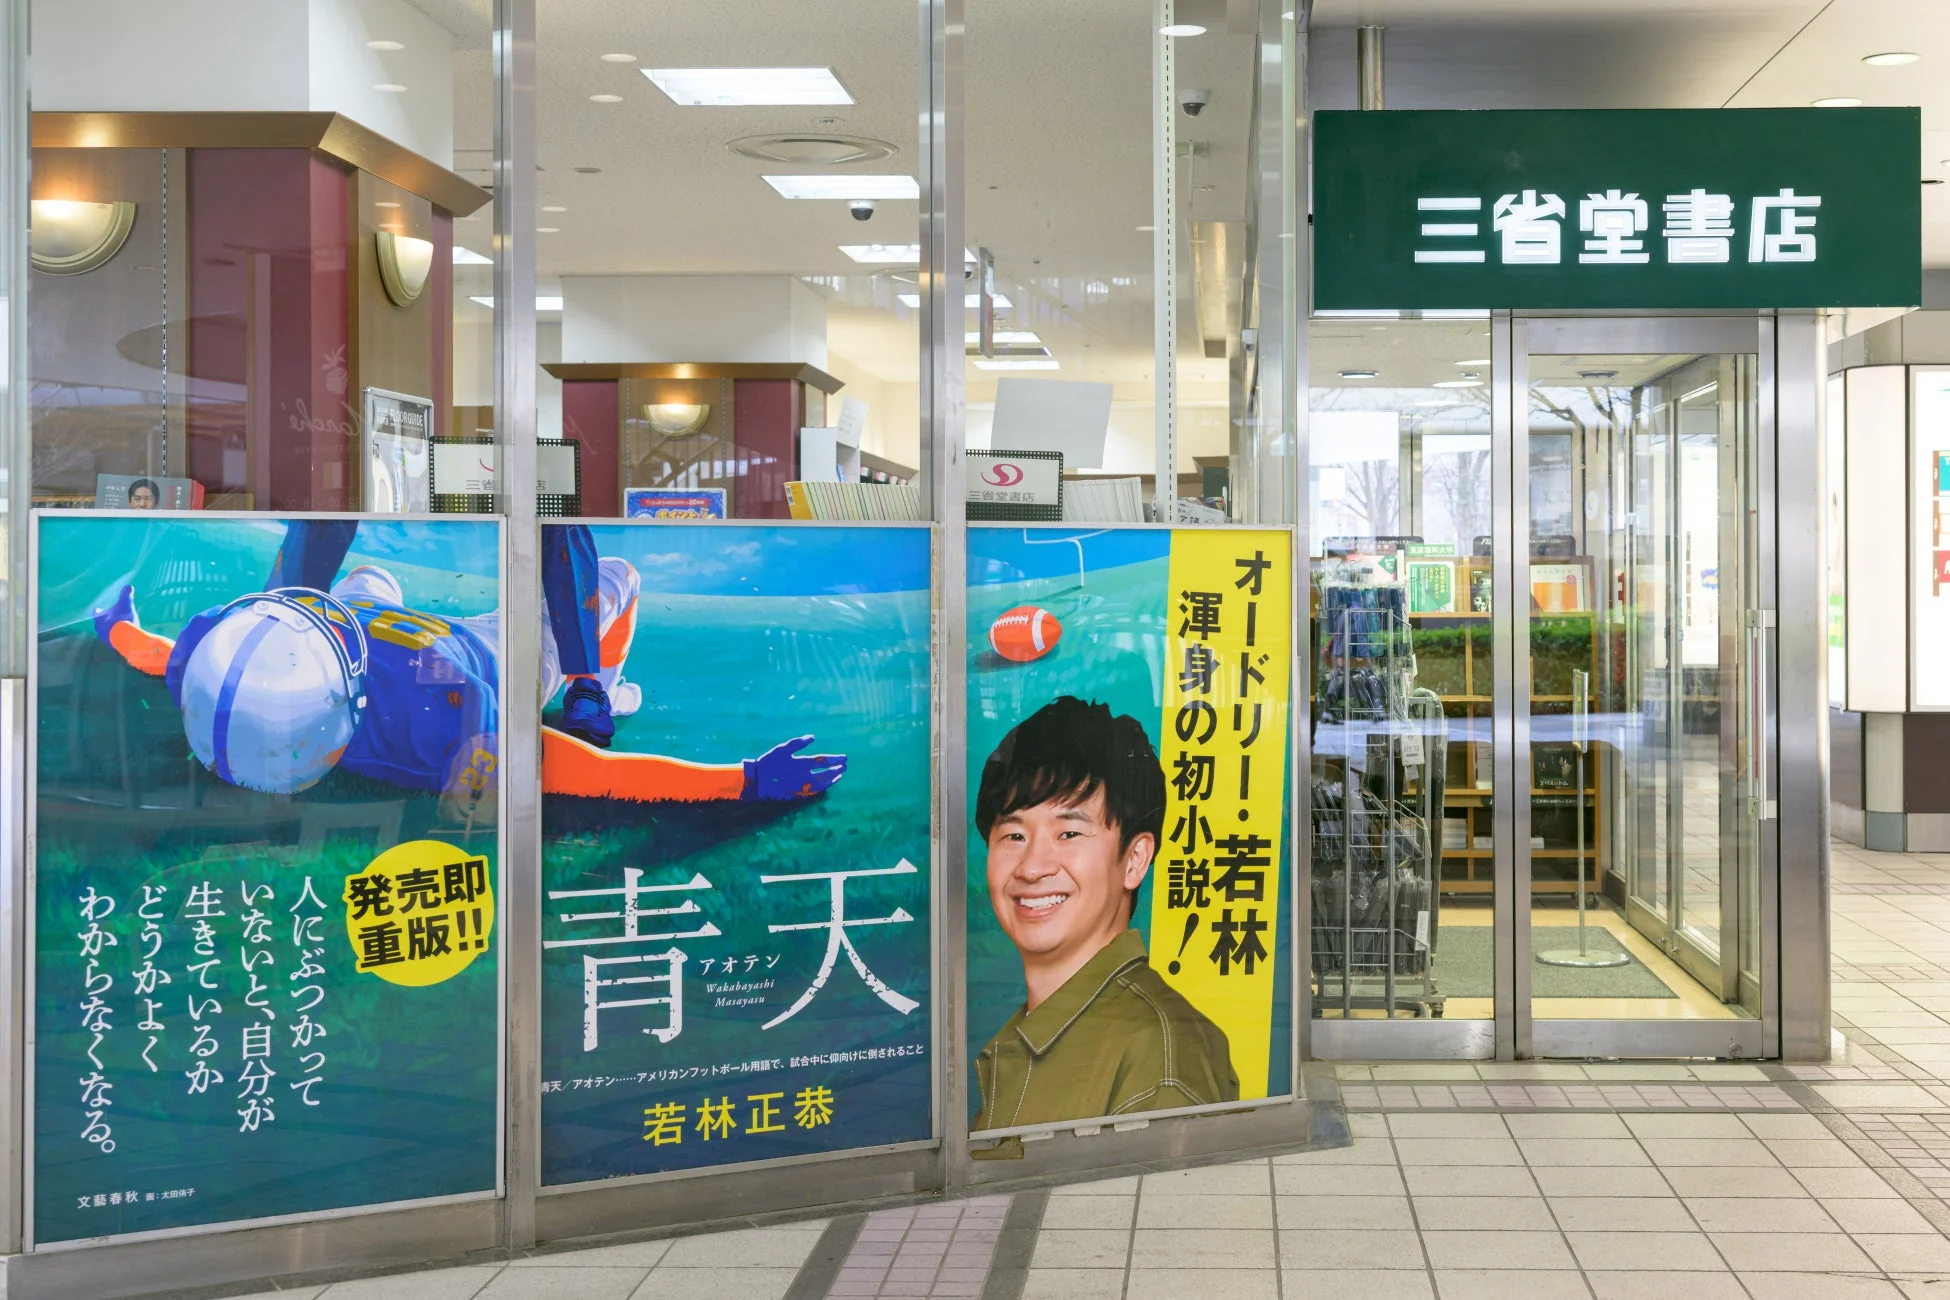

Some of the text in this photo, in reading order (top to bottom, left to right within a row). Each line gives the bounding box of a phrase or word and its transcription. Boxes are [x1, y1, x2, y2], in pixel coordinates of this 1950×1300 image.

[1414, 188, 1822, 264] 三省堂書店
[967, 490, 1035, 502] 三省堂書店
[1208, 550, 1272, 976] オードリー・若林
[348, 860, 486, 921] 発売即
[132, 885, 171, 1073] どうかよく
[184, 881, 226, 1095] 生きているか
[289, 876, 328, 1106] 人にぶつかって
[542, 857, 921, 1052] 青天
[699, 953, 781, 976] アオテン
[706, 979, 776, 994] Wakabayashi
[77, 886, 118, 1154] わからなくなる。
[237, 880, 277, 1133] いないと、自分が
[714, 996, 766, 1008] Masayasu
[642, 1085, 834, 1147] 若林正恭
[77, 1190, 139, 1209] 文藝春秋
